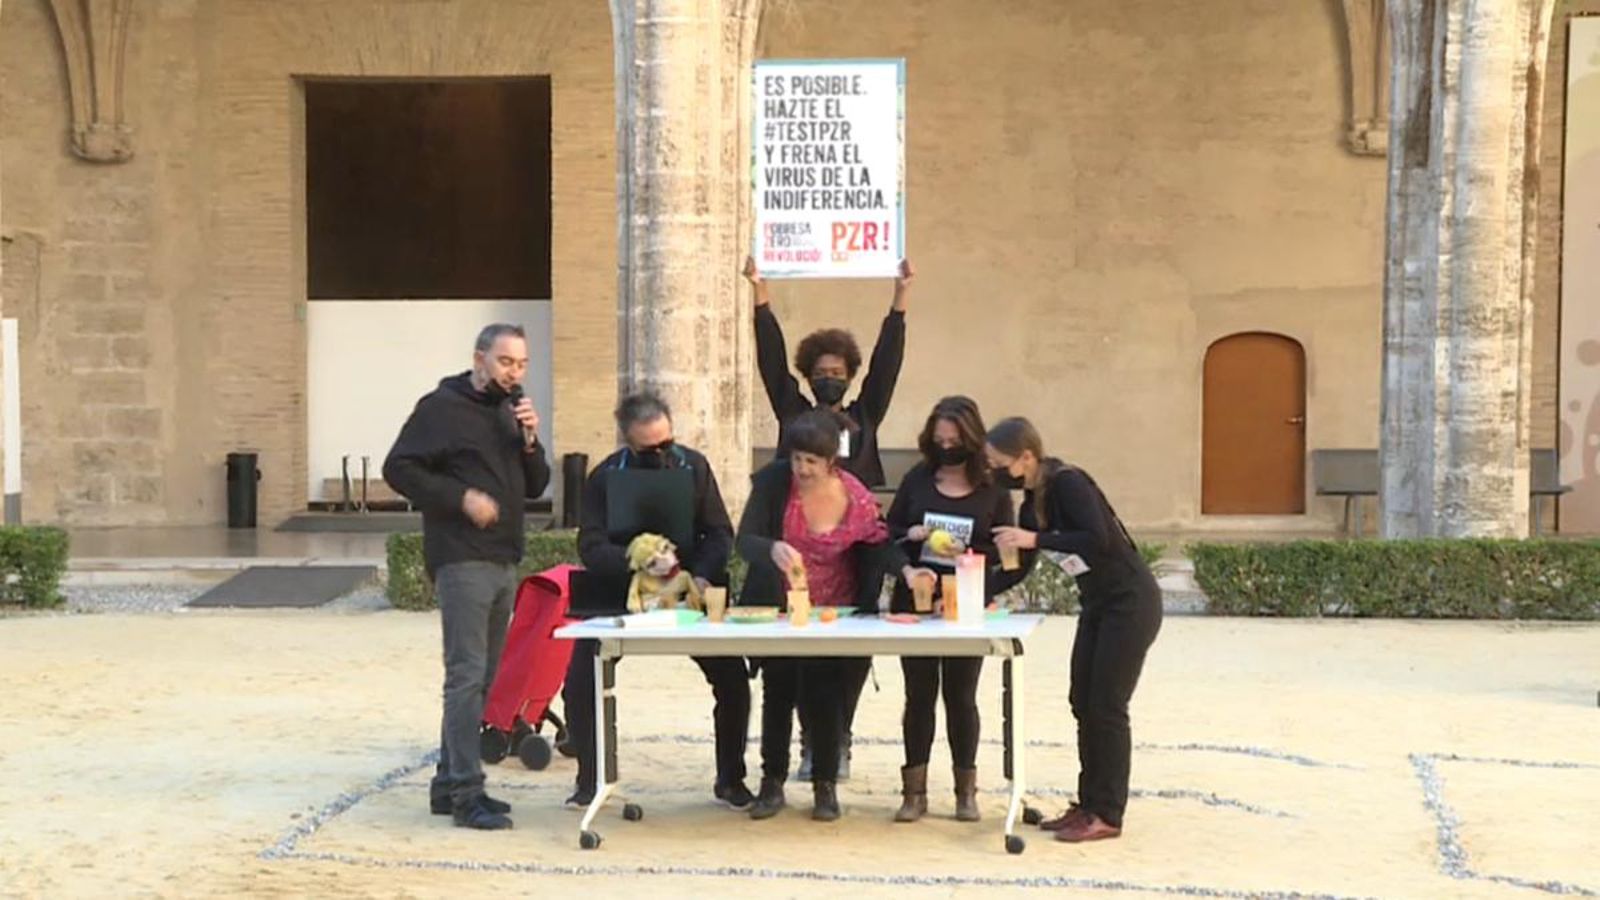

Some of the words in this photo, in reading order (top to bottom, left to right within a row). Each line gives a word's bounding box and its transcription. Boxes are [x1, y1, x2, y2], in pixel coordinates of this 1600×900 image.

[764, 76, 785, 96] ES
[791, 76, 868, 96] POSIBLE.
[764, 99, 818, 118] HAZTE
[825, 99, 844, 118] EL
[764, 121, 851, 141] #TESTPZR
[764, 144, 775, 164] Y
[781, 144, 837, 164] FRENA
[843, 144, 862, 164] EL
[765, 167, 816, 187] VIRUS
[822, 167, 843, 187] DE
[849, 167, 870, 187] LA
[764, 189, 888, 210] INDIFERENCIA.
